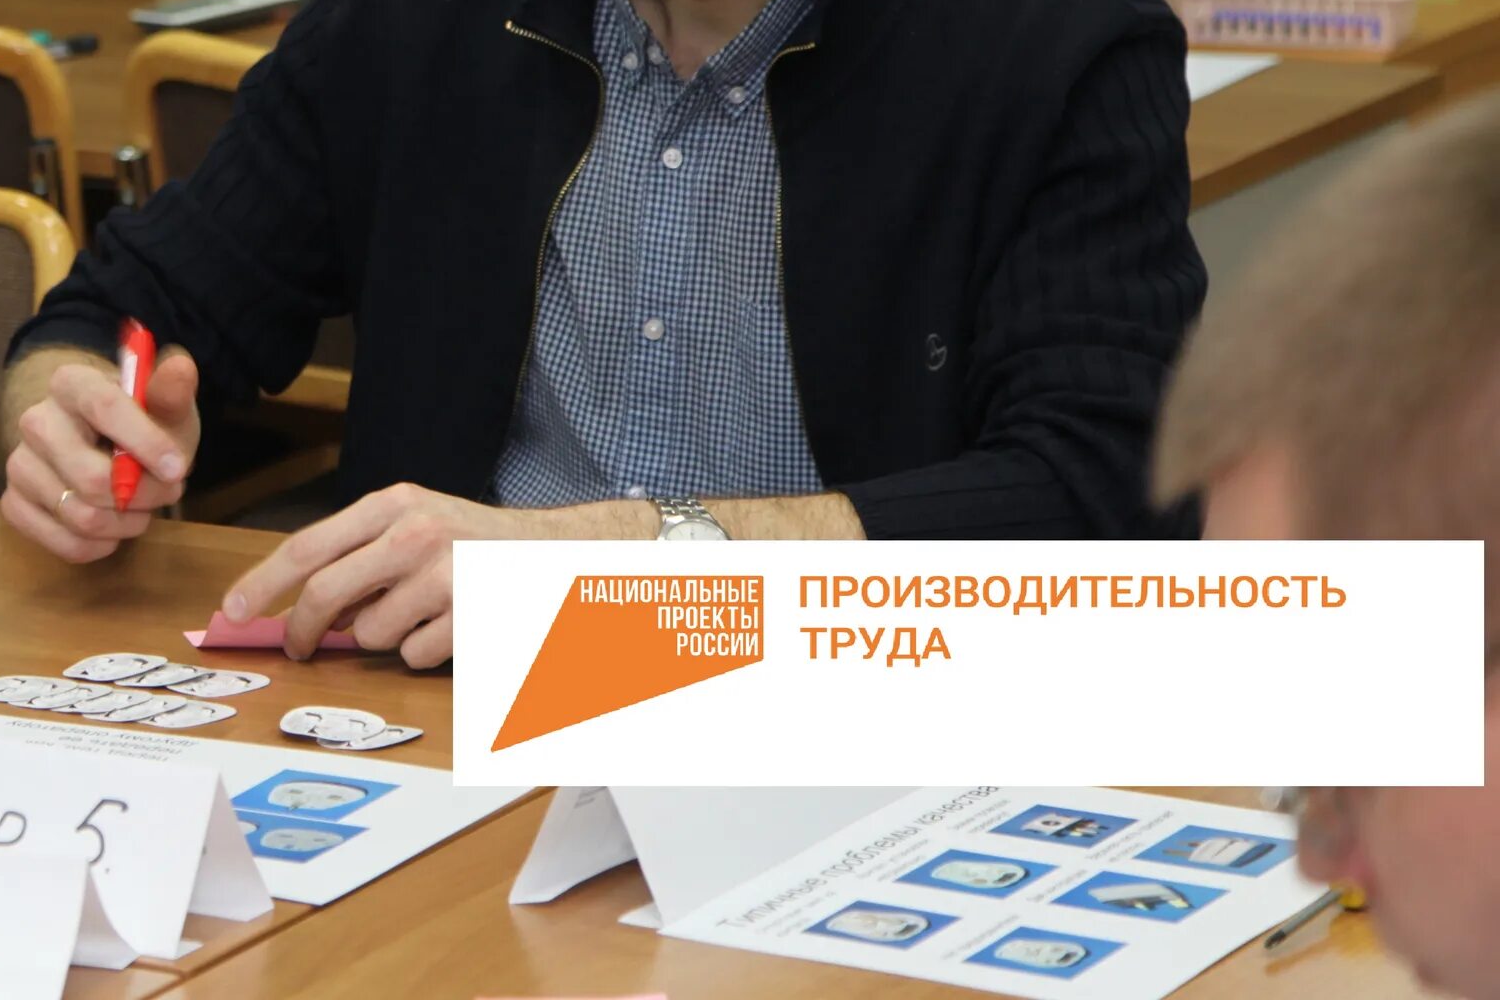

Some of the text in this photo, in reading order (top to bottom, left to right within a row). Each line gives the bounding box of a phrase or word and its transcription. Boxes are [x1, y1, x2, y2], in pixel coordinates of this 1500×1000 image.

[715, 870, 828, 930] Типичные
[819, 823, 922, 884] проблемы
[916, 786, 1000, 832] качества
